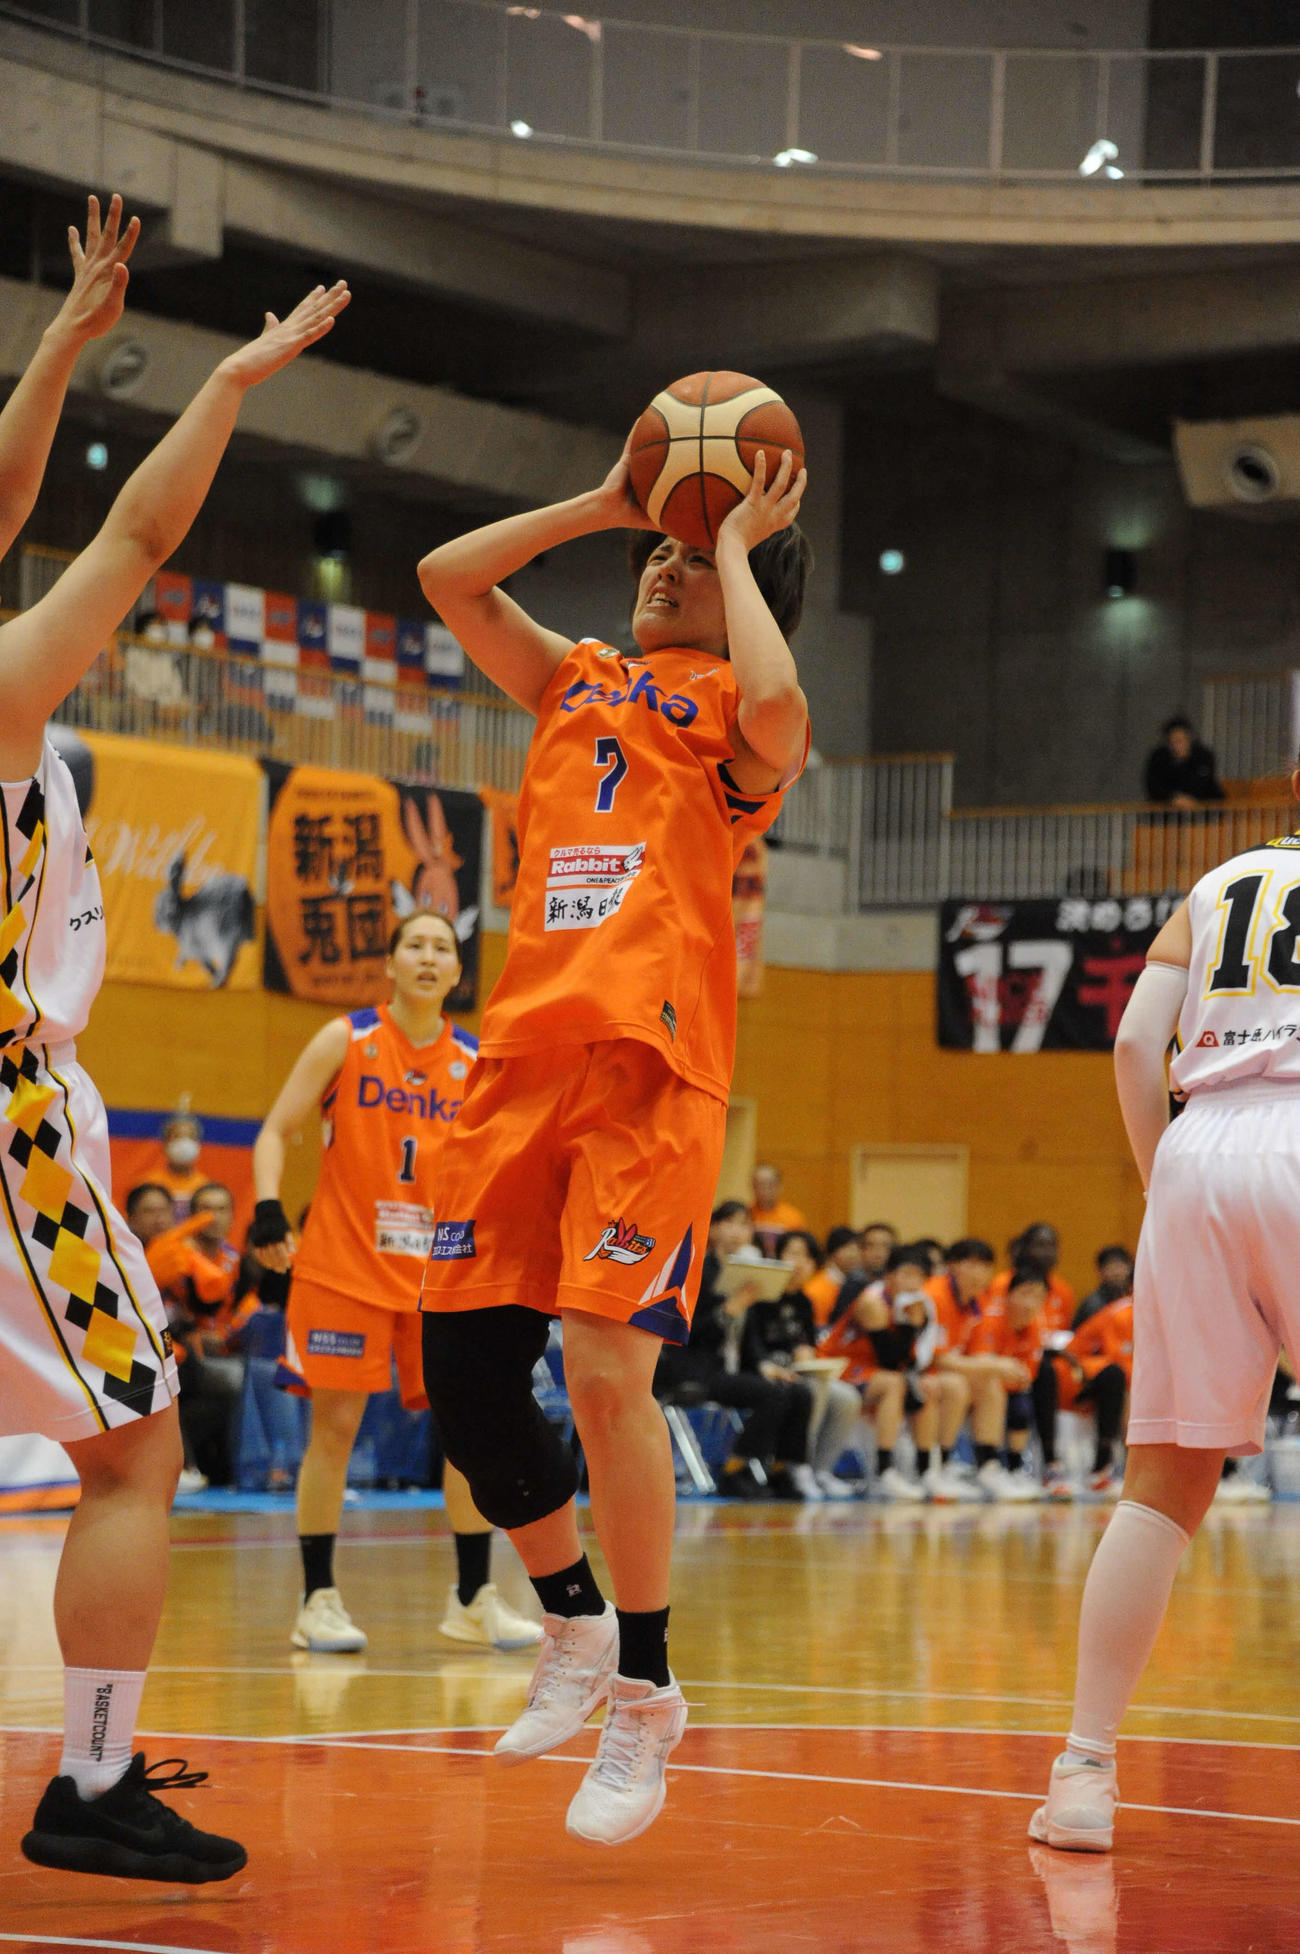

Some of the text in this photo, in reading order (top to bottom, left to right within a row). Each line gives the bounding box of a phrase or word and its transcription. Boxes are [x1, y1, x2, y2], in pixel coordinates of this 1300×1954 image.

[560, 671, 699, 728] Dka
[593, 736, 628, 812] 7
[551, 858, 621, 875] Rabbit
[953, 939, 1073, 1053] 17
[398, 1136, 417, 1184] 1
